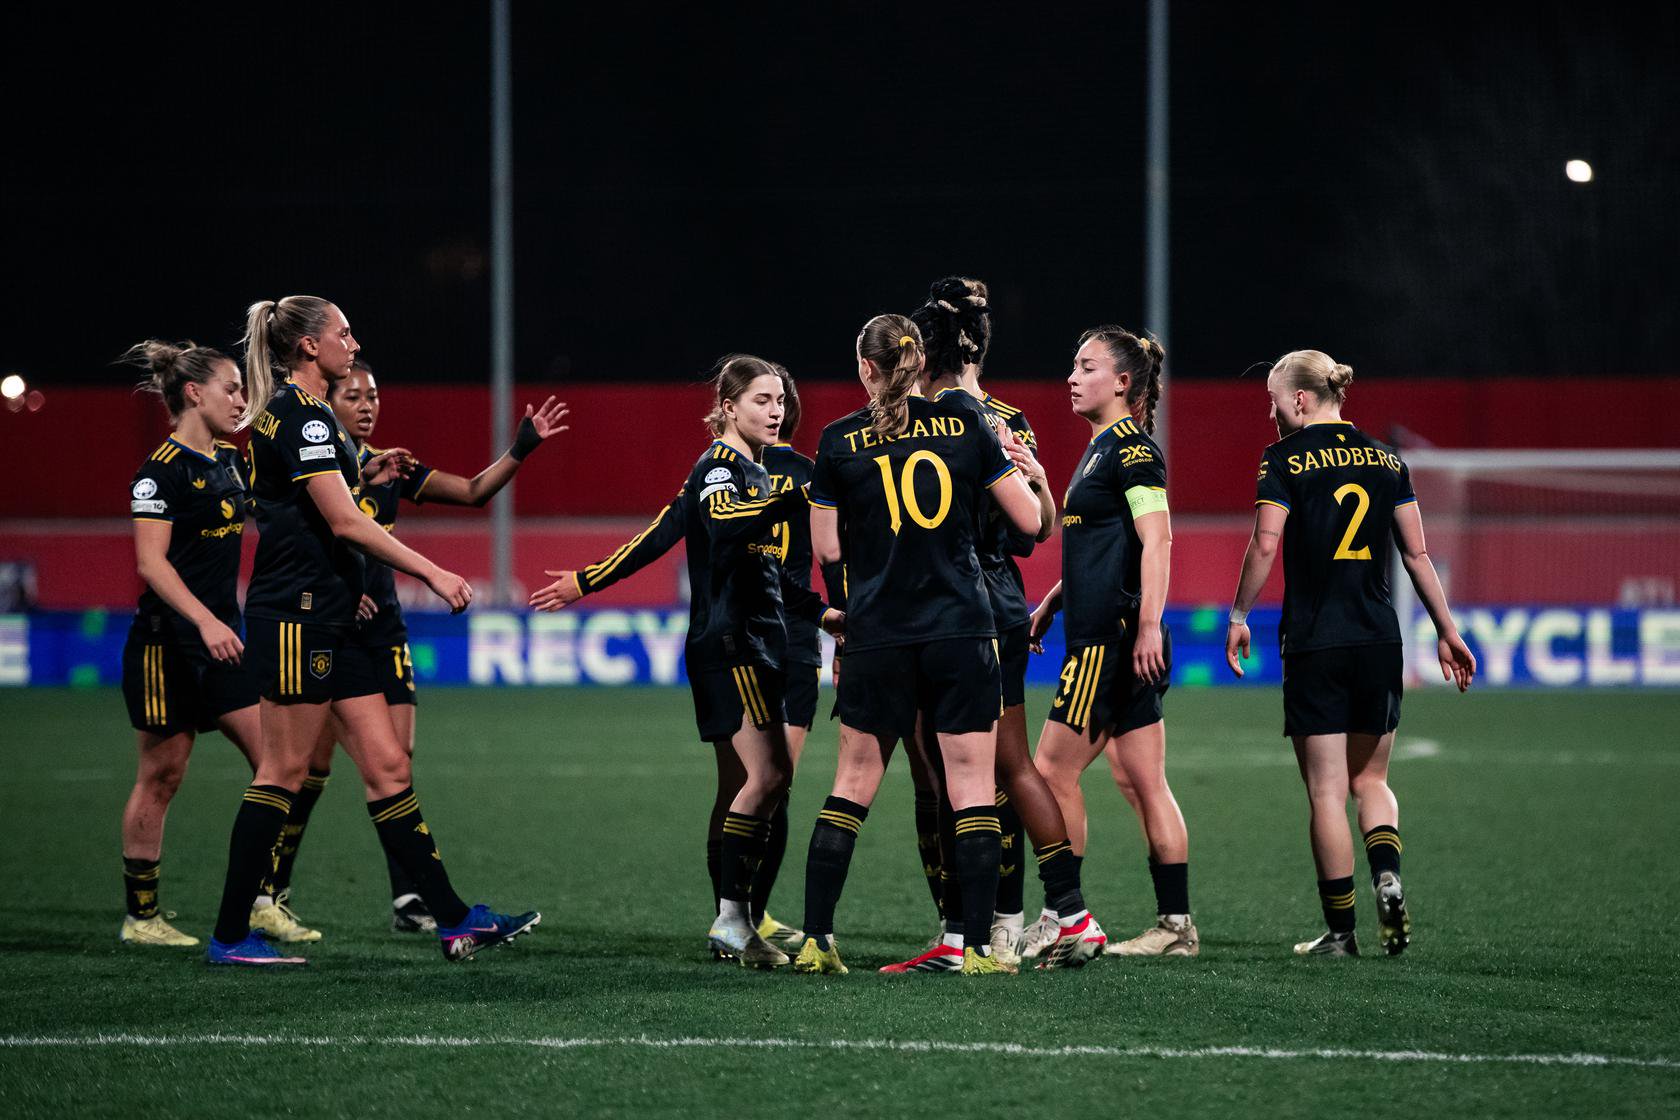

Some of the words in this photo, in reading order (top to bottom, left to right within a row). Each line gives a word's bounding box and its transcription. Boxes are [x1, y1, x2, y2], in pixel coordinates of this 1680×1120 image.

[843, 417, 965, 453] TEAND
[1287, 447, 1401, 475] SANDBERG
[873, 449, 953, 537] 10
[1333, 483, 1372, 560] 2
[1060, 655, 1078, 695] 4
